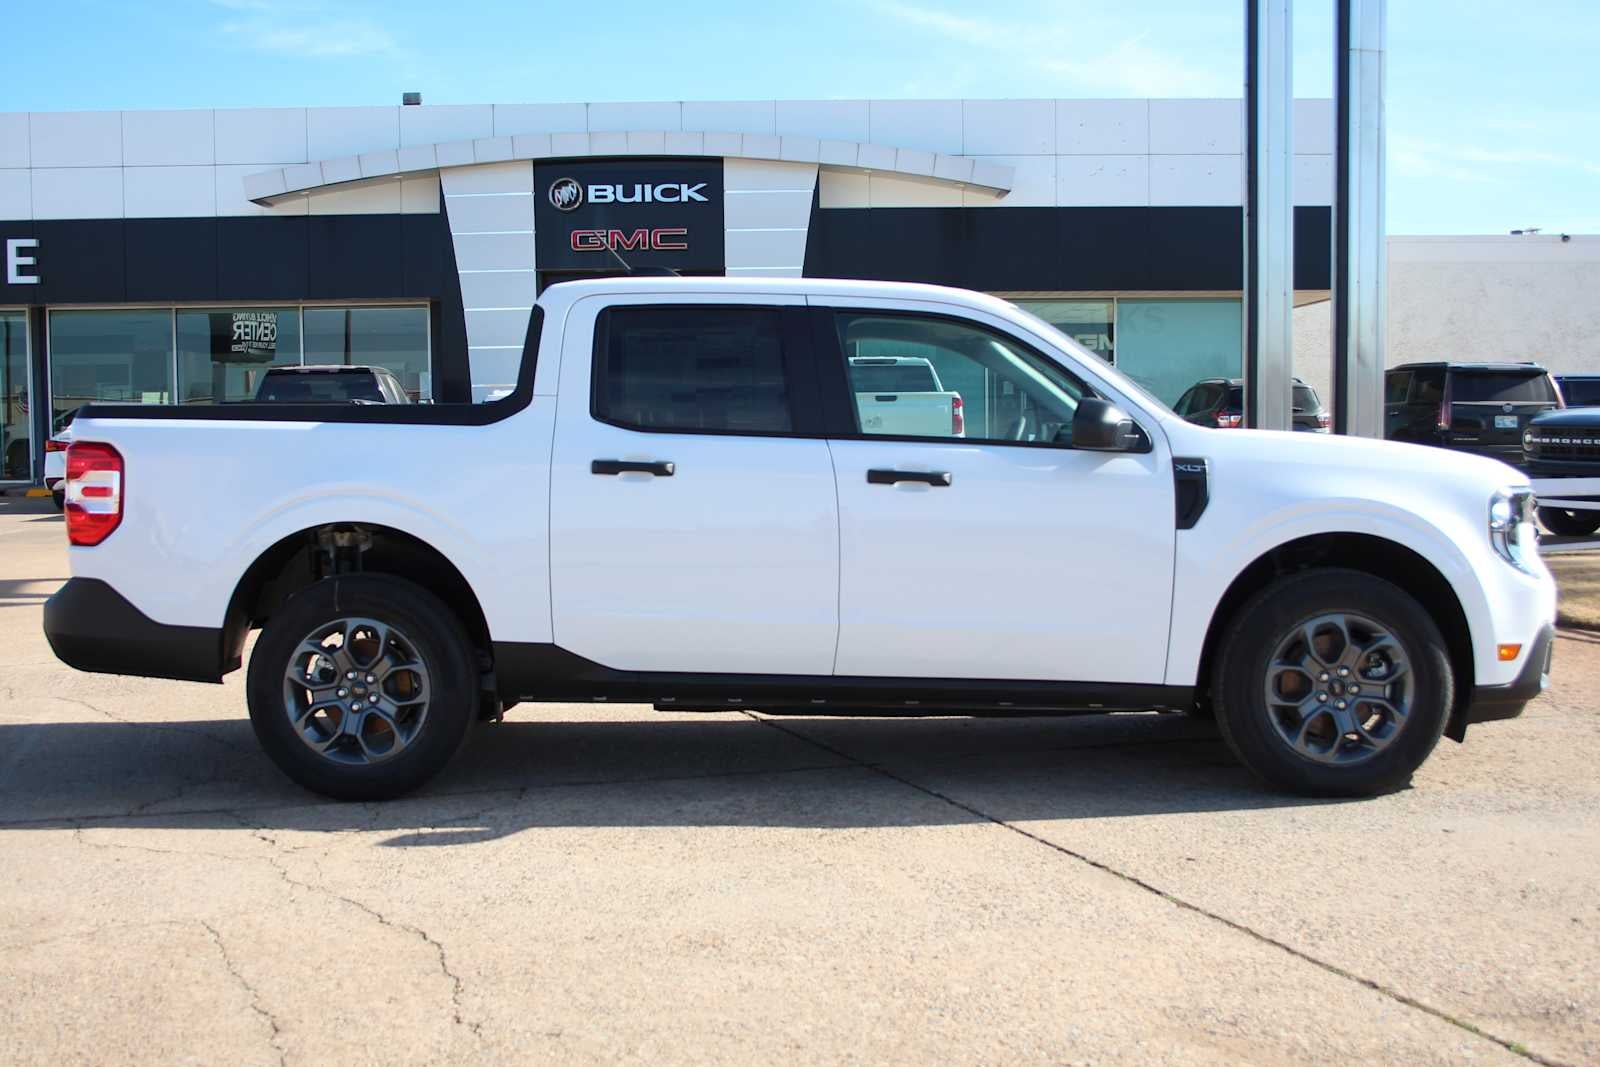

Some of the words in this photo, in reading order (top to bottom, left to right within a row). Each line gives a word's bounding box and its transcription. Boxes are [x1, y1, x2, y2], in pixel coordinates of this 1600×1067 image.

[588, 183, 709, 203] BUICK
[571, 228, 688, 251] GMC
[7, 238, 40, 284] E
